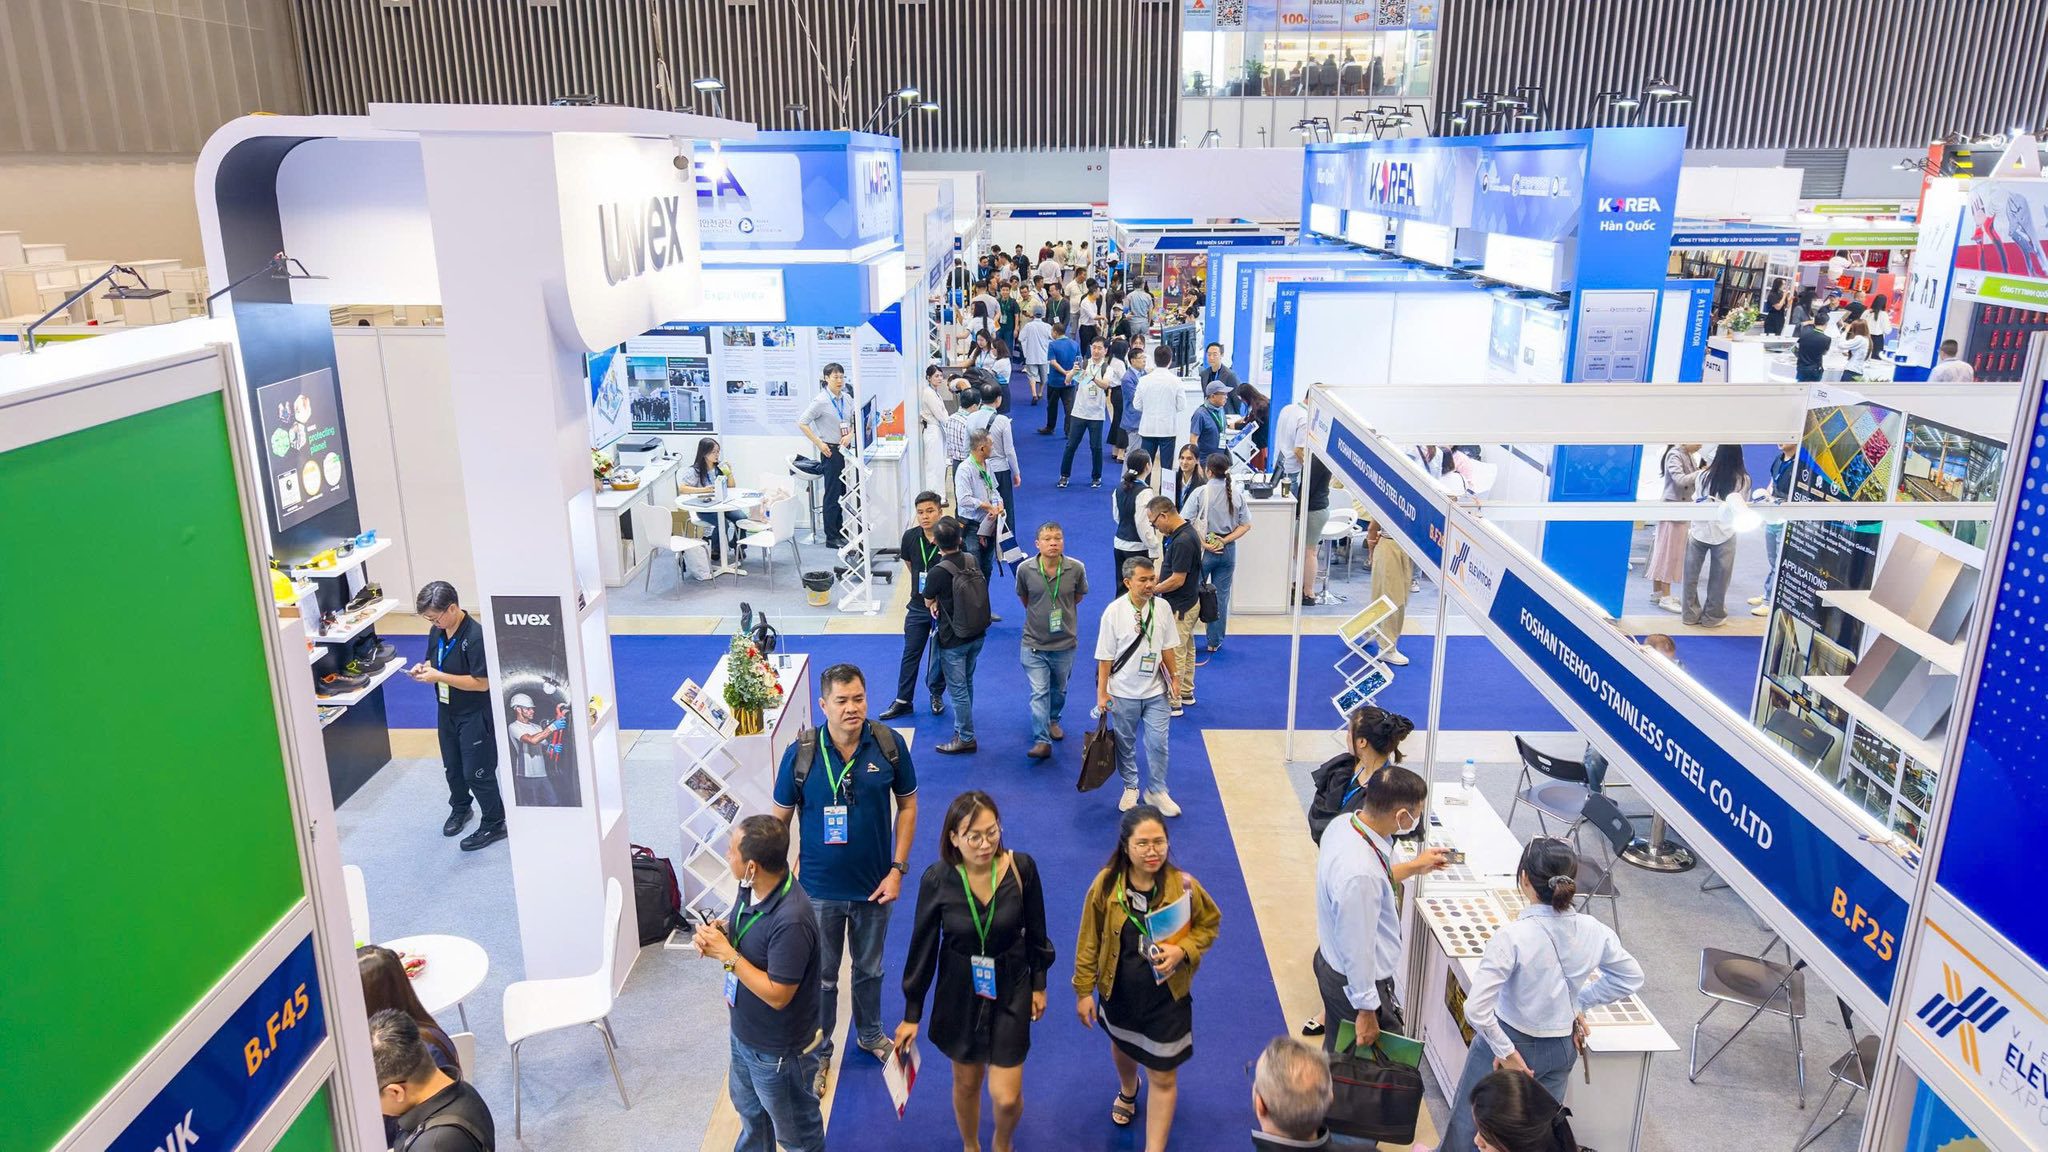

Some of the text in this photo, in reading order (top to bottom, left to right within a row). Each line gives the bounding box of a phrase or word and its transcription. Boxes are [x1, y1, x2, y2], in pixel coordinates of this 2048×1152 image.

[1282, 14, 1308, 24] 100+
[1370, 159, 1416, 206] KOREA
[1598, 197, 1661, 213] KOREA
[1600, 219, 1656, 232] Hàn Quốc
[598, 196, 684, 287] uvex
[1284, 301, 1292, 314] ERC
[1692, 310, 1705, 346] ELEVATOR
[1706, 360, 1721, 372] PATTA
[308, 426, 335, 444] protecting
[310, 440, 327, 454] planet
[1385, 479, 1398, 506] STEEL
[1781, 557, 1827, 591] APPLICATIONS
[504, 613, 551, 626] uvex
[1520, 607, 1773, 850] FOSHAN TEEHOO STAINLESS STEEL CO.,LTD
[1831, 886, 1895, 962] B.F25
[243, 983, 310, 1077] B.F45
